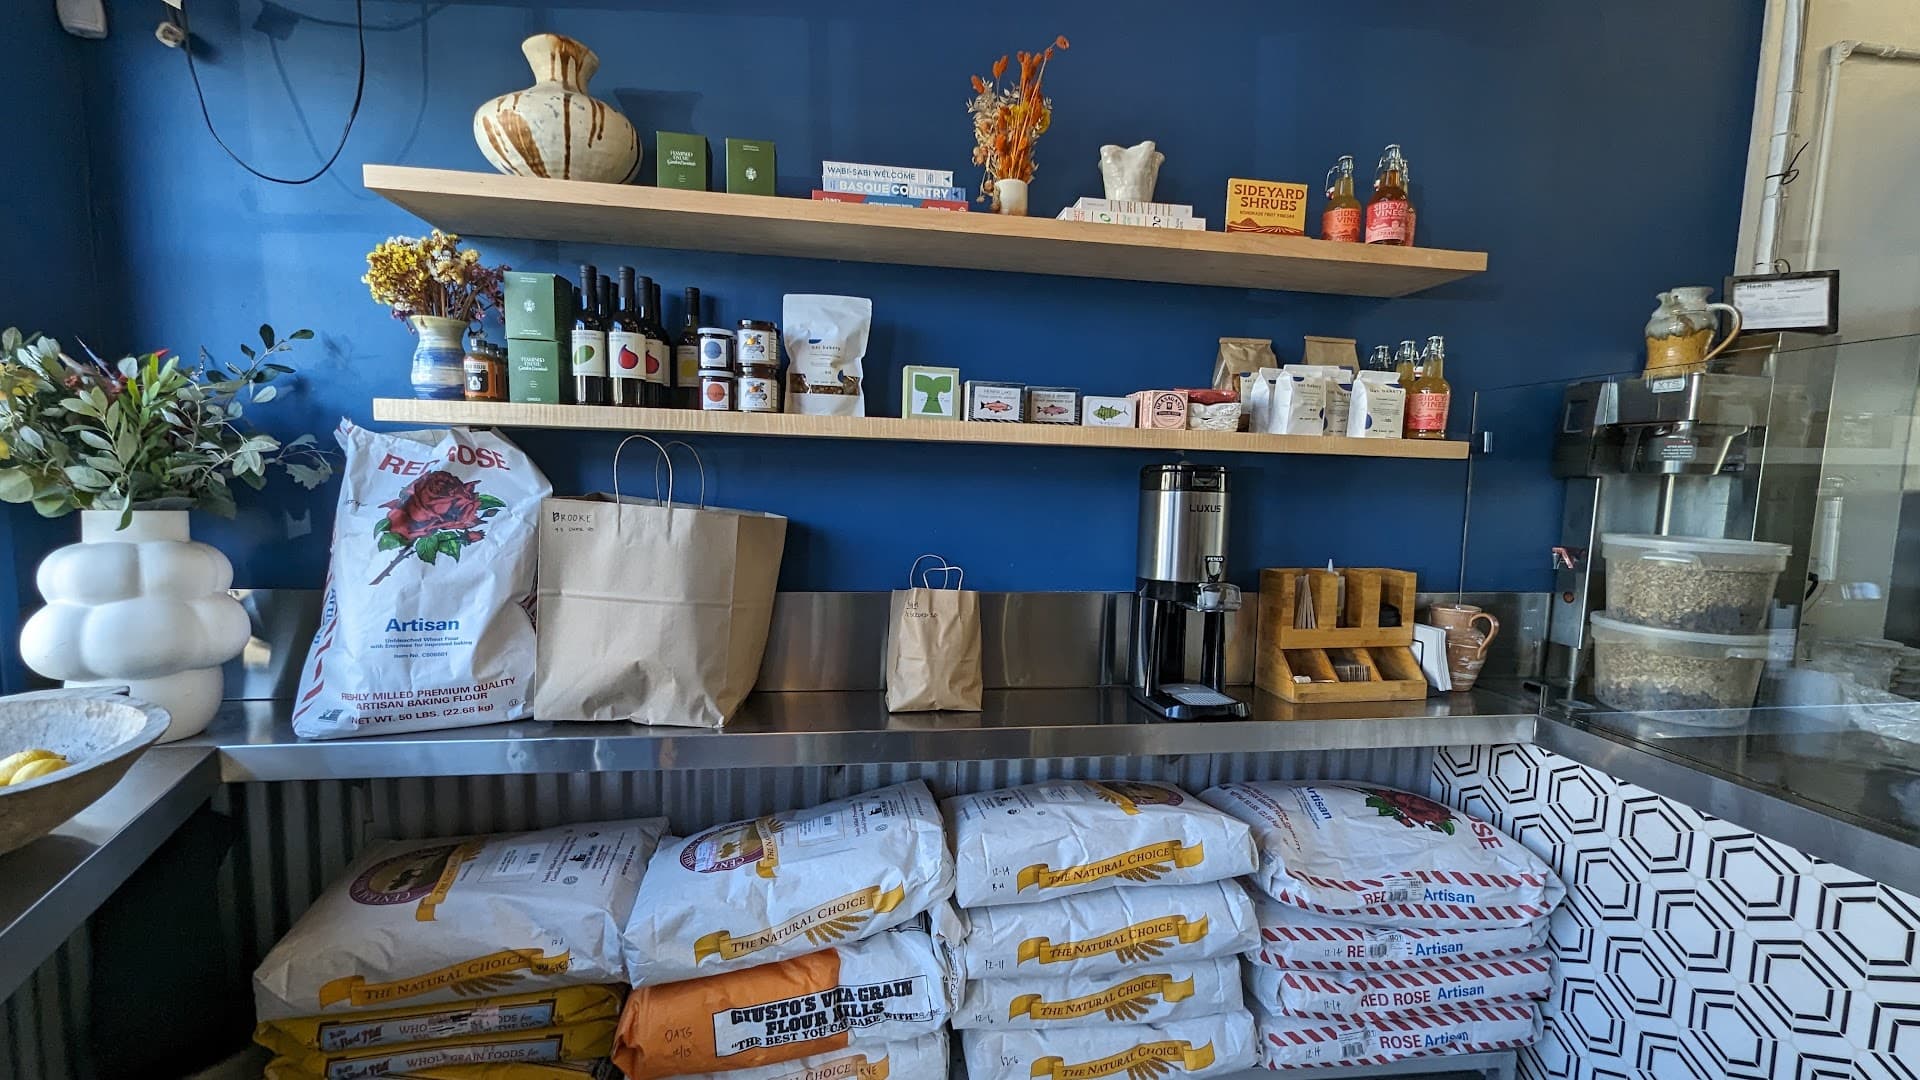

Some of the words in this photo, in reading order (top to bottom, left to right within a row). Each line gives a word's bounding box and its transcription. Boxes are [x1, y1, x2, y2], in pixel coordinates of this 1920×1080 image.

[827, 167, 871, 177] WABI-SABI
[873, 169, 916, 180] WELCOME
[839, 179, 890, 192] BASQUE
[891, 184, 949, 199] COUNTRY
[1234, 184, 1305, 200] SIDEYARD
[1240, 197, 1297, 212] SHRUBS
[552, 511, 592, 523] BROOKE
[1190, 504, 1222, 513] LUXUS
[385, 618, 459, 632] Artisan
[373, 690, 413, 700] MILLED
[417, 686, 470, 698] PREMIUM
[473, 677, 516, 692] QUALITY
[356, 701, 404, 711] ARTISAN
[407, 697, 450, 707] BAKING
[453, 692, 488, 703] FLOUR
[351, 716, 371, 725] NET
[374, 715, 395, 723] WT.
[399, 713, 412, 721] 50
[478, 704, 494, 713] kg)
[1471, 823, 1503, 850] SE
[1048, 872, 1070, 885] THE
[1072, 859, 1125, 882] NATURAL
[1128, 847, 1170, 864] CHOICE
[1424, 888, 1475, 904] Artisan
[731, 937, 757, 953] THE
[760, 914, 815, 945] NATURAL
[817, 896, 867, 920] CHOICE
[1050, 946, 1072, 958] THE
[1074, 933, 1127, 956] NATURAL
[1129, 921, 1173, 939] CHOICE
[1347, 945, 1365, 958] RE
[1416, 941, 1463, 956] Artisan
[363, 988, 392, 1001] THE
[397, 969, 463, 994] NATURAL
[468, 955, 525, 975] CHOICE
[1040, 1006, 1064, 1017] THE
[1066, 991, 1115, 1014] NATURAL
[1117, 978, 1157, 998] CHOICE
[1361, 993, 1389, 1007] RED
[1393, 990, 1431, 1006] ROSE
[1437, 985, 1484, 1001] Artisan
[731, 996, 817, 1024] GIUSTO'S
[765, 1011, 829, 1036] FLOUR
[833, 1001, 885, 1024] MILLS
[400, 1023, 428, 1034] WHO
[766, 1032, 798, 1046] BEST
[804, 1025, 827, 1040] YOU
[850, 1015, 881, 1029] BAKE
[1379, 1034, 1422, 1049] ROSE
[1425, 1031, 1468, 1048] Artisan
[451, 1052, 484, 1062] GRAIN
[488, 1049, 525, 1060] FOODS
[1063, 1067, 1085, 1078] THE
[1088, 1053, 1136, 1076] NATURAL
[1138, 1045, 1178, 1058] CHOICE
[806, 1063, 851, 1080] CHOICE
